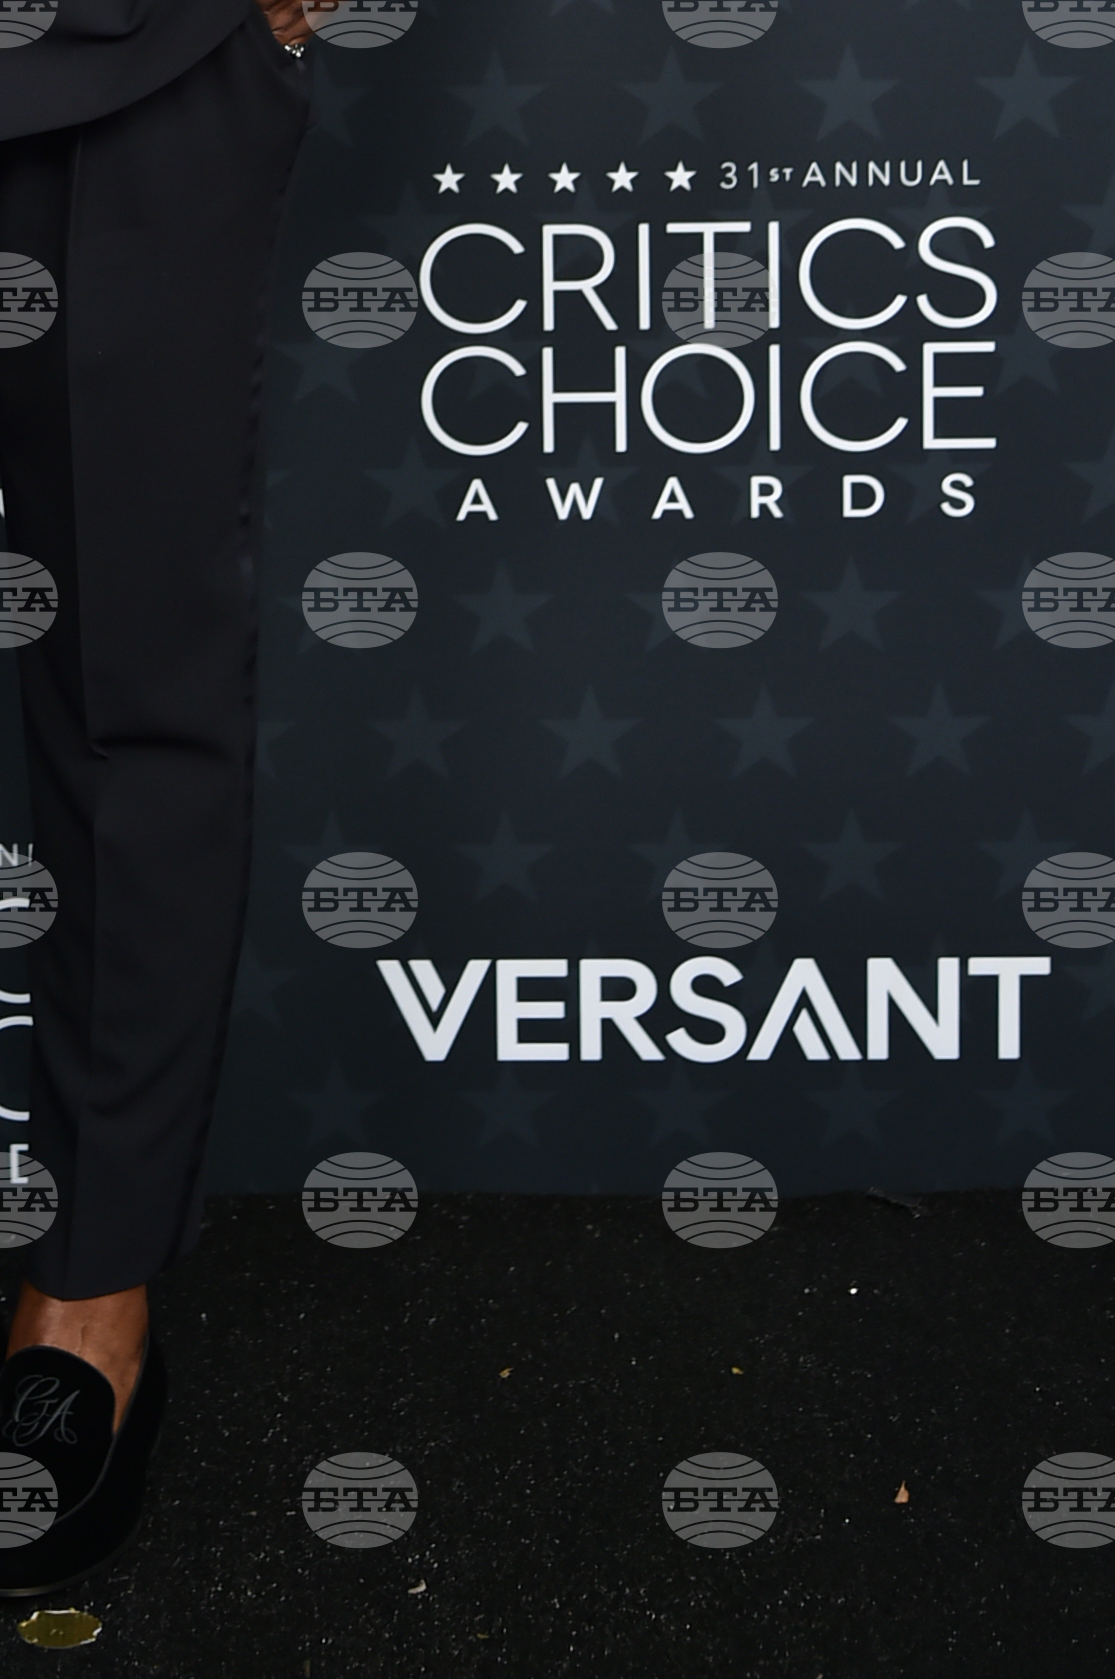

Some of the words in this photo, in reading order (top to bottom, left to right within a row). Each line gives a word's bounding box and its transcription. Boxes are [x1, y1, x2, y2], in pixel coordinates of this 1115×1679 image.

[801, 159, 982, 188] ANNUAL
[419, 216, 998, 334] CRITICS
[421, 341, 997, 456] CHOICE
[456, 473, 976, 521] AWARDS
[376, 955, 1052, 1063] VERSANT
